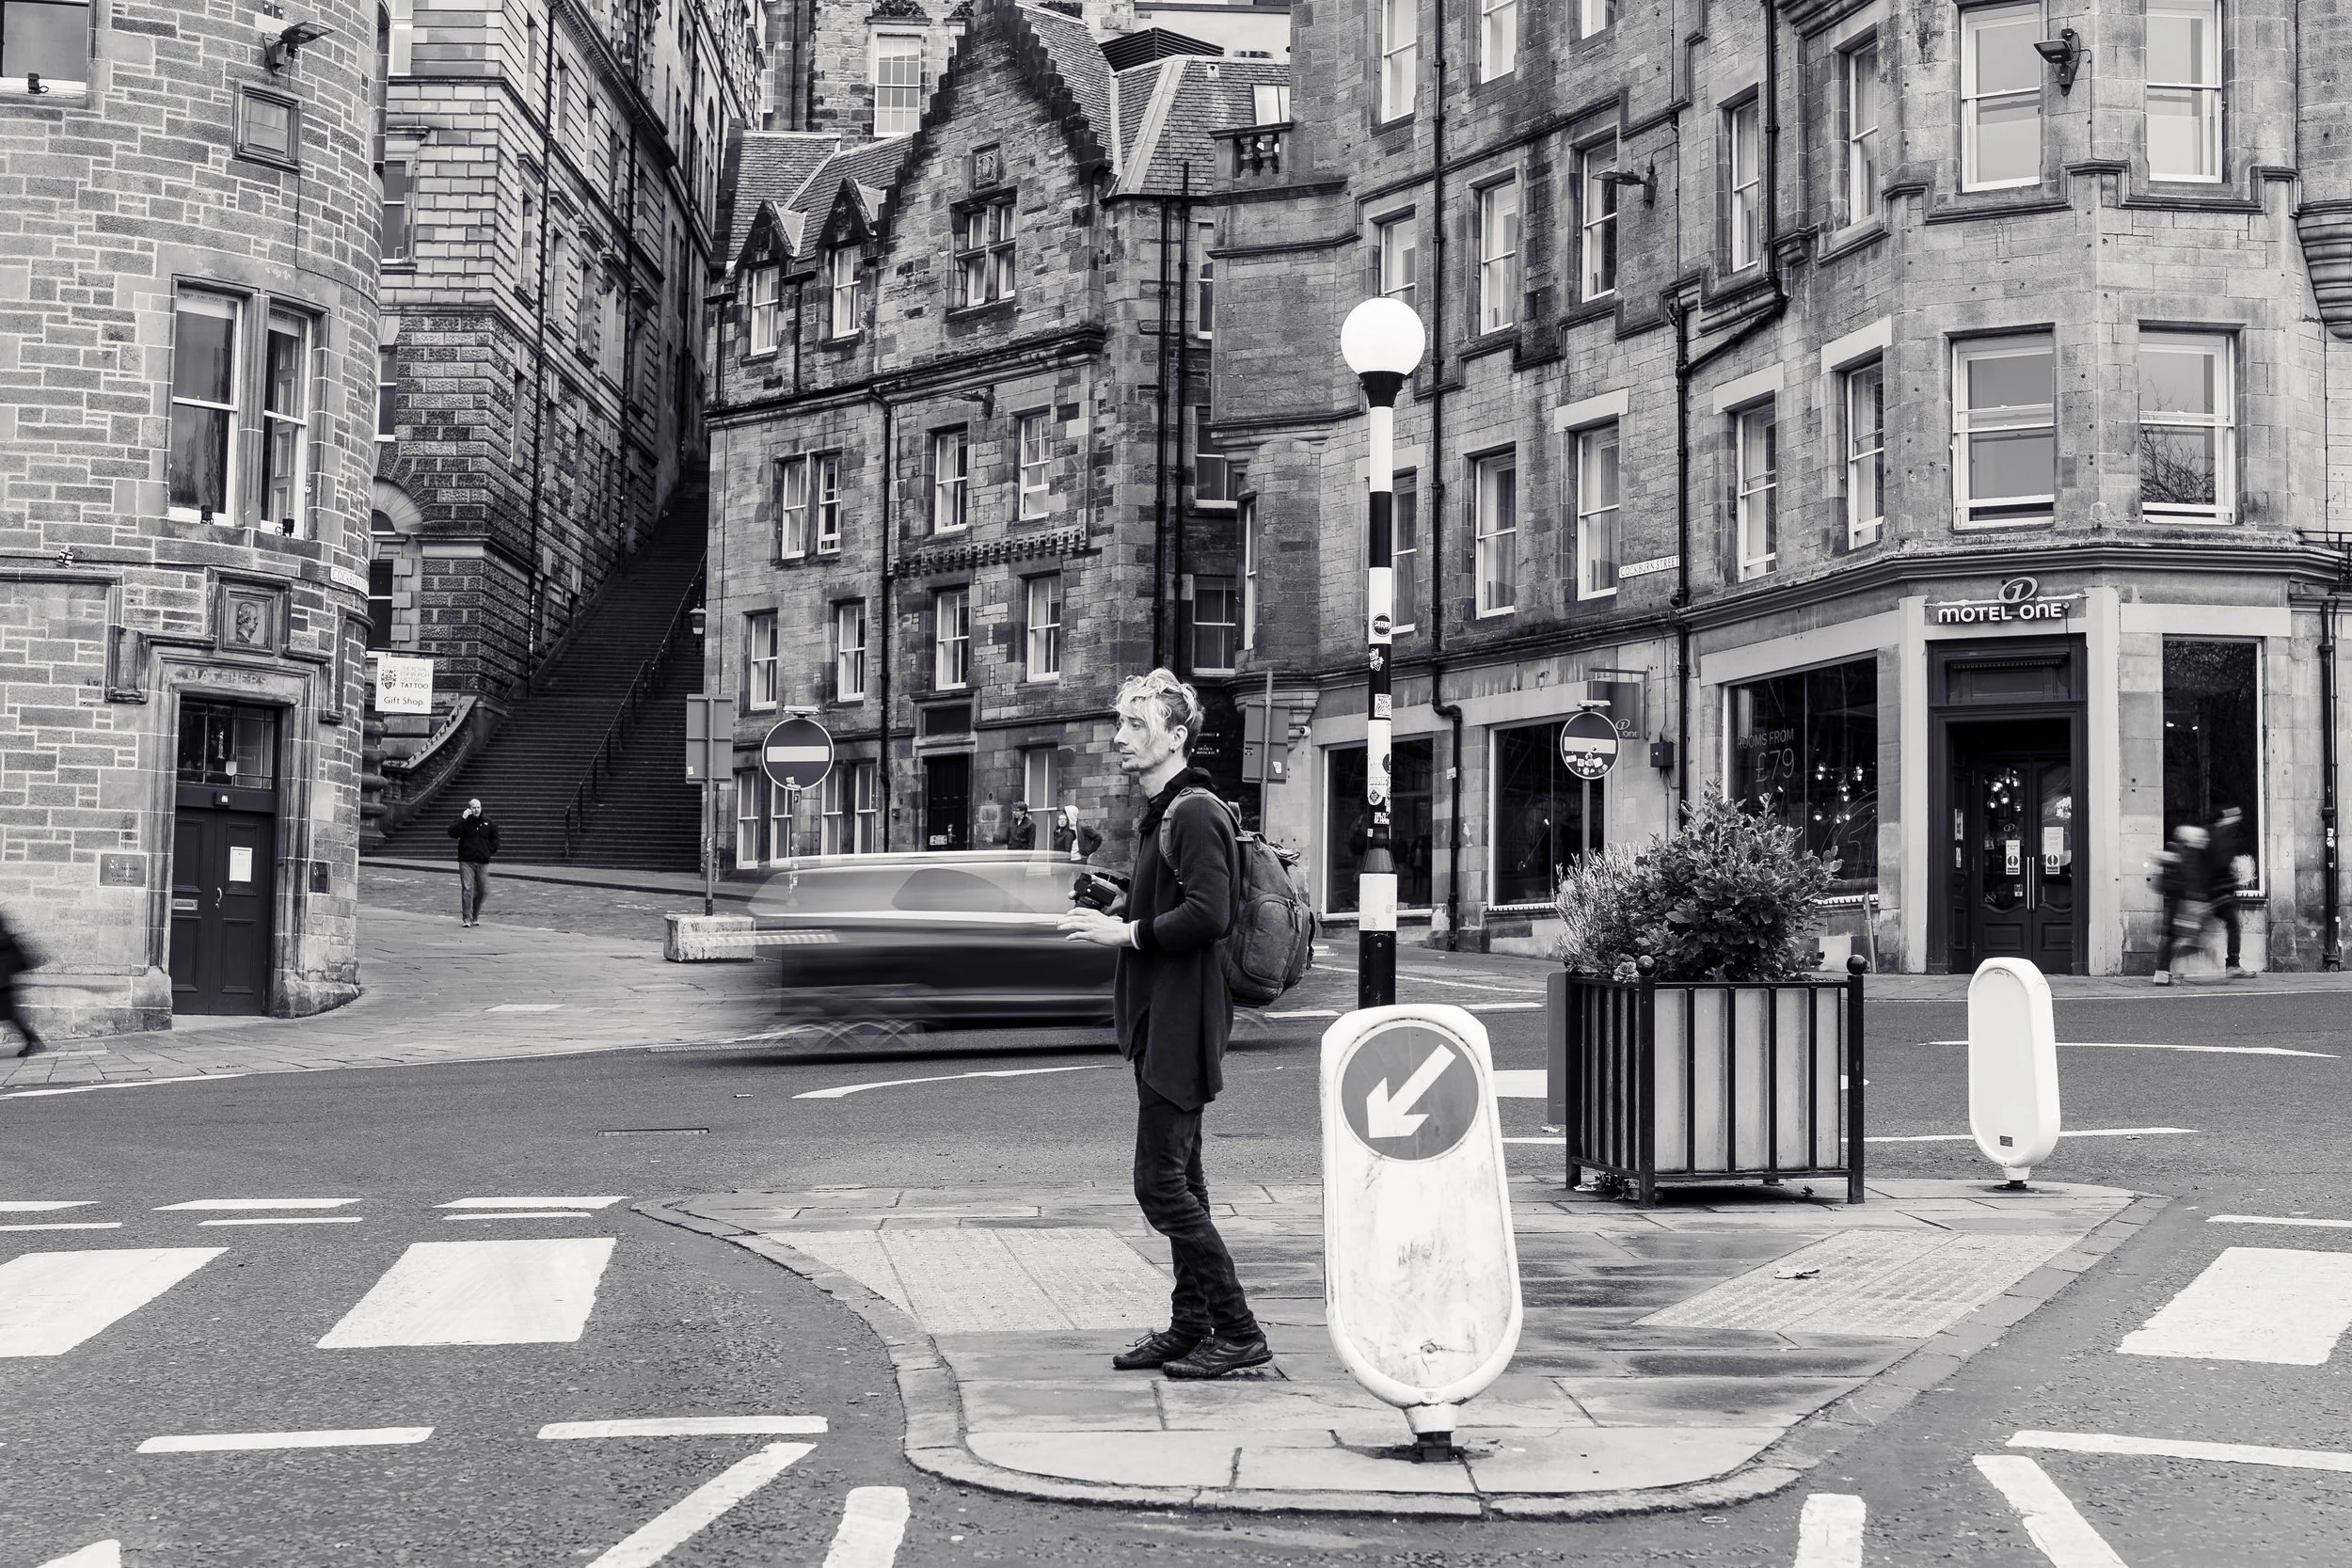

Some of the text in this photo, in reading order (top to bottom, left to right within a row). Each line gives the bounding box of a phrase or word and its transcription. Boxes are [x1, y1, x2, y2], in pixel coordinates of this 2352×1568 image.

[1620, 557, 1679, 577] COCKBURN STREET
[1938, 603, 2062, 623] MOTEL ONE
[384, 696, 423, 707] Gift Shop
[1622, 730, 1640, 738] ONE
[1738, 728, 1794, 750] ROOMS FROM
[1756, 748, 1795, 783] £79
